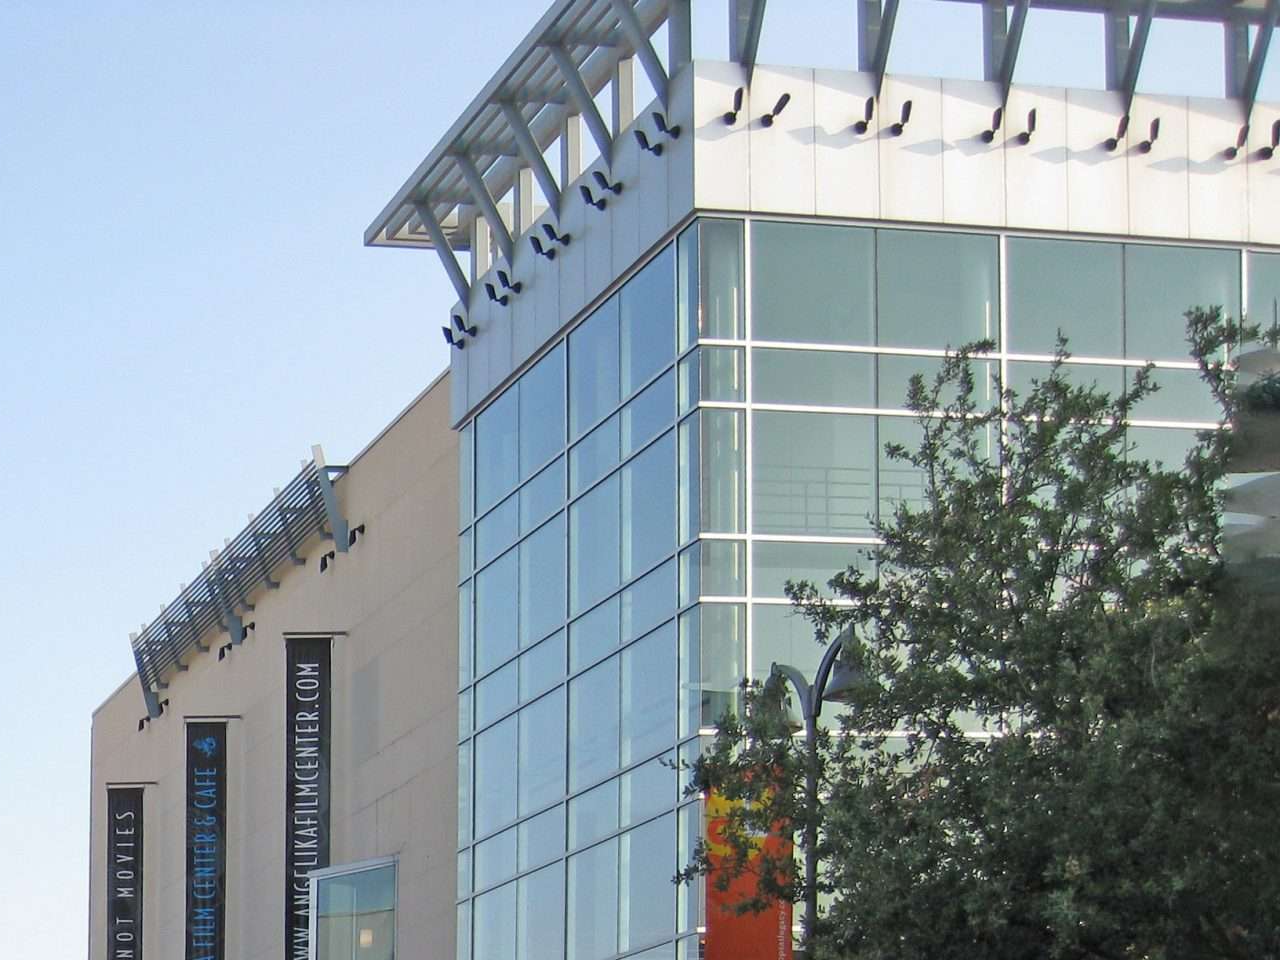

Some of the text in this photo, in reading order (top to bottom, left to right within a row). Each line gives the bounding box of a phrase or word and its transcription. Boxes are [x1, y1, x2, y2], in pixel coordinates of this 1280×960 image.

[194, 767, 217, 809] CAFE
[194, 816, 217, 826] &
[116, 811, 135, 897] MOVIES
[194, 833, 217, 899] CENTER
[116, 917, 134, 958] NOT
[193, 908, 216, 946] FILM
